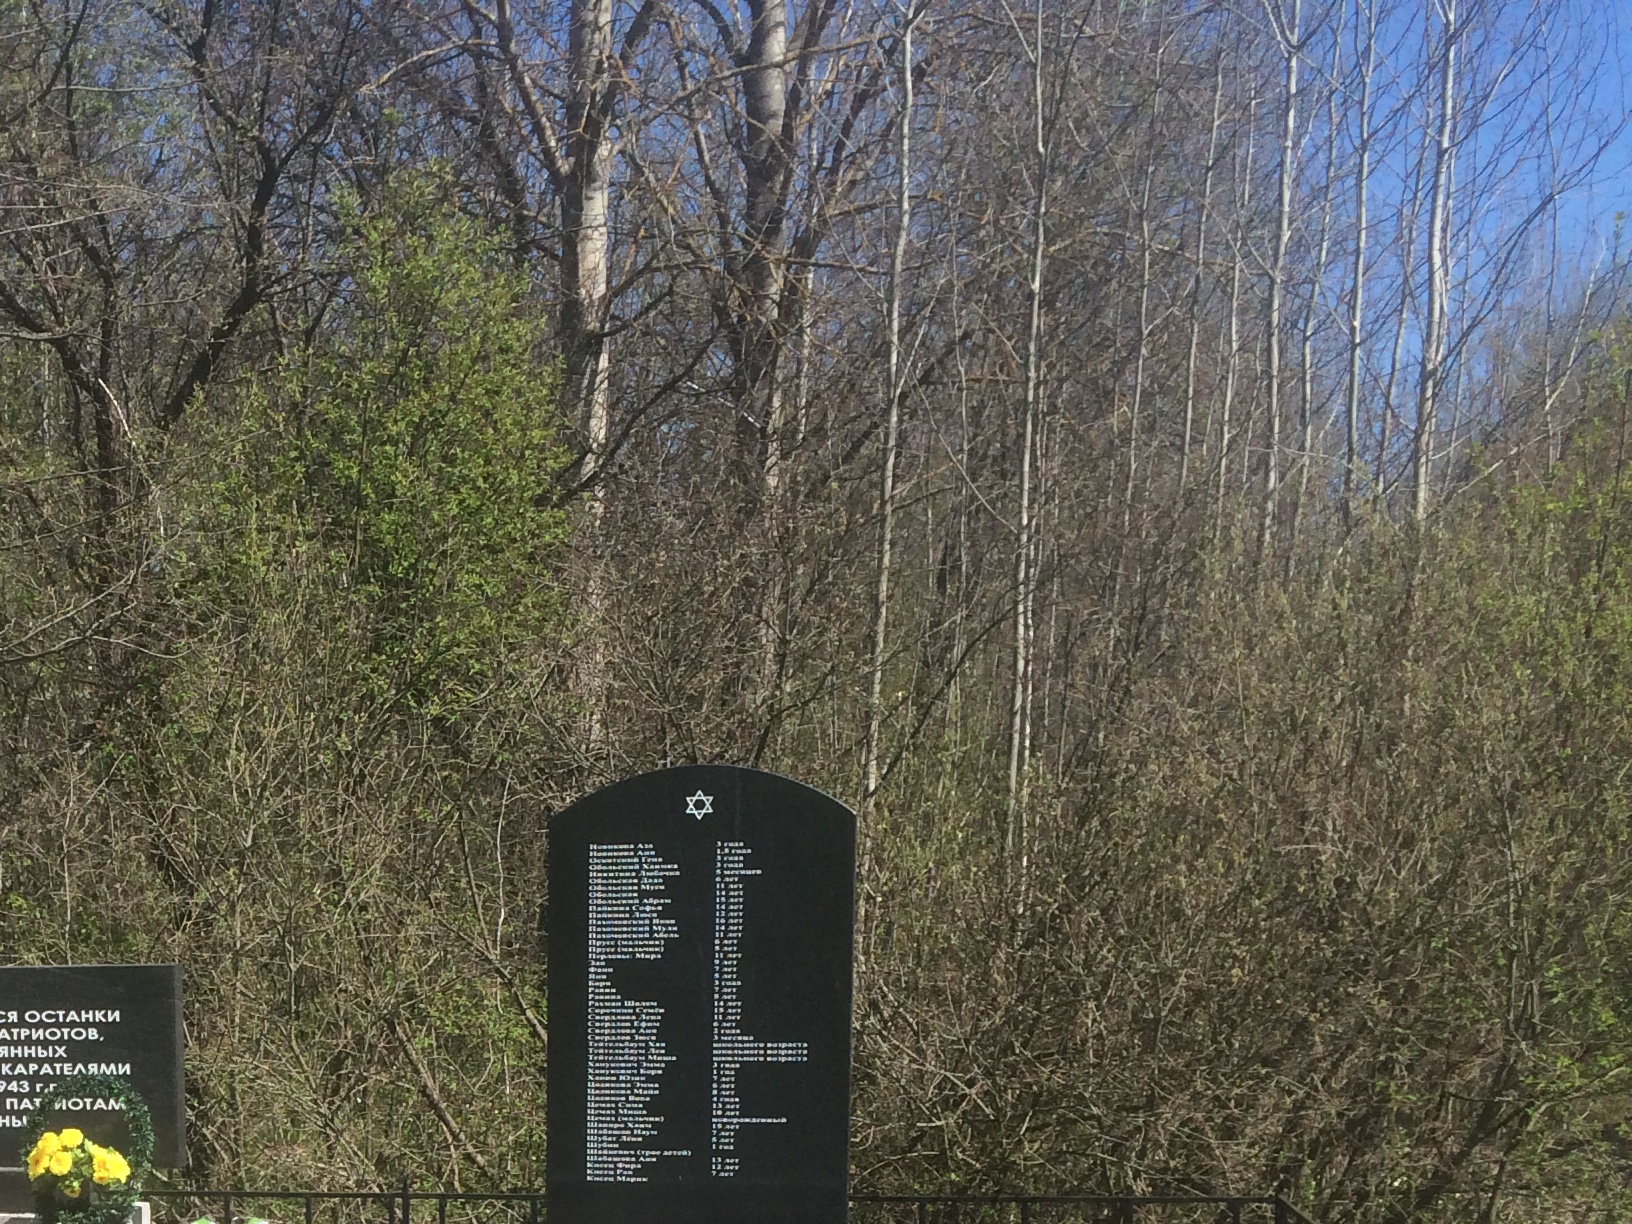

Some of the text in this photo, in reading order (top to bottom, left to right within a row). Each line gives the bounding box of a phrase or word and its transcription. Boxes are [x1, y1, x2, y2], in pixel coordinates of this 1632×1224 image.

[24, 1010, 120, 1023] ОСТАНКИ
[2, 1062, 131, 1076] КАРАТЕЛЯМИ
[6, 1097, 126, 1111] ПАТИОТАМ
